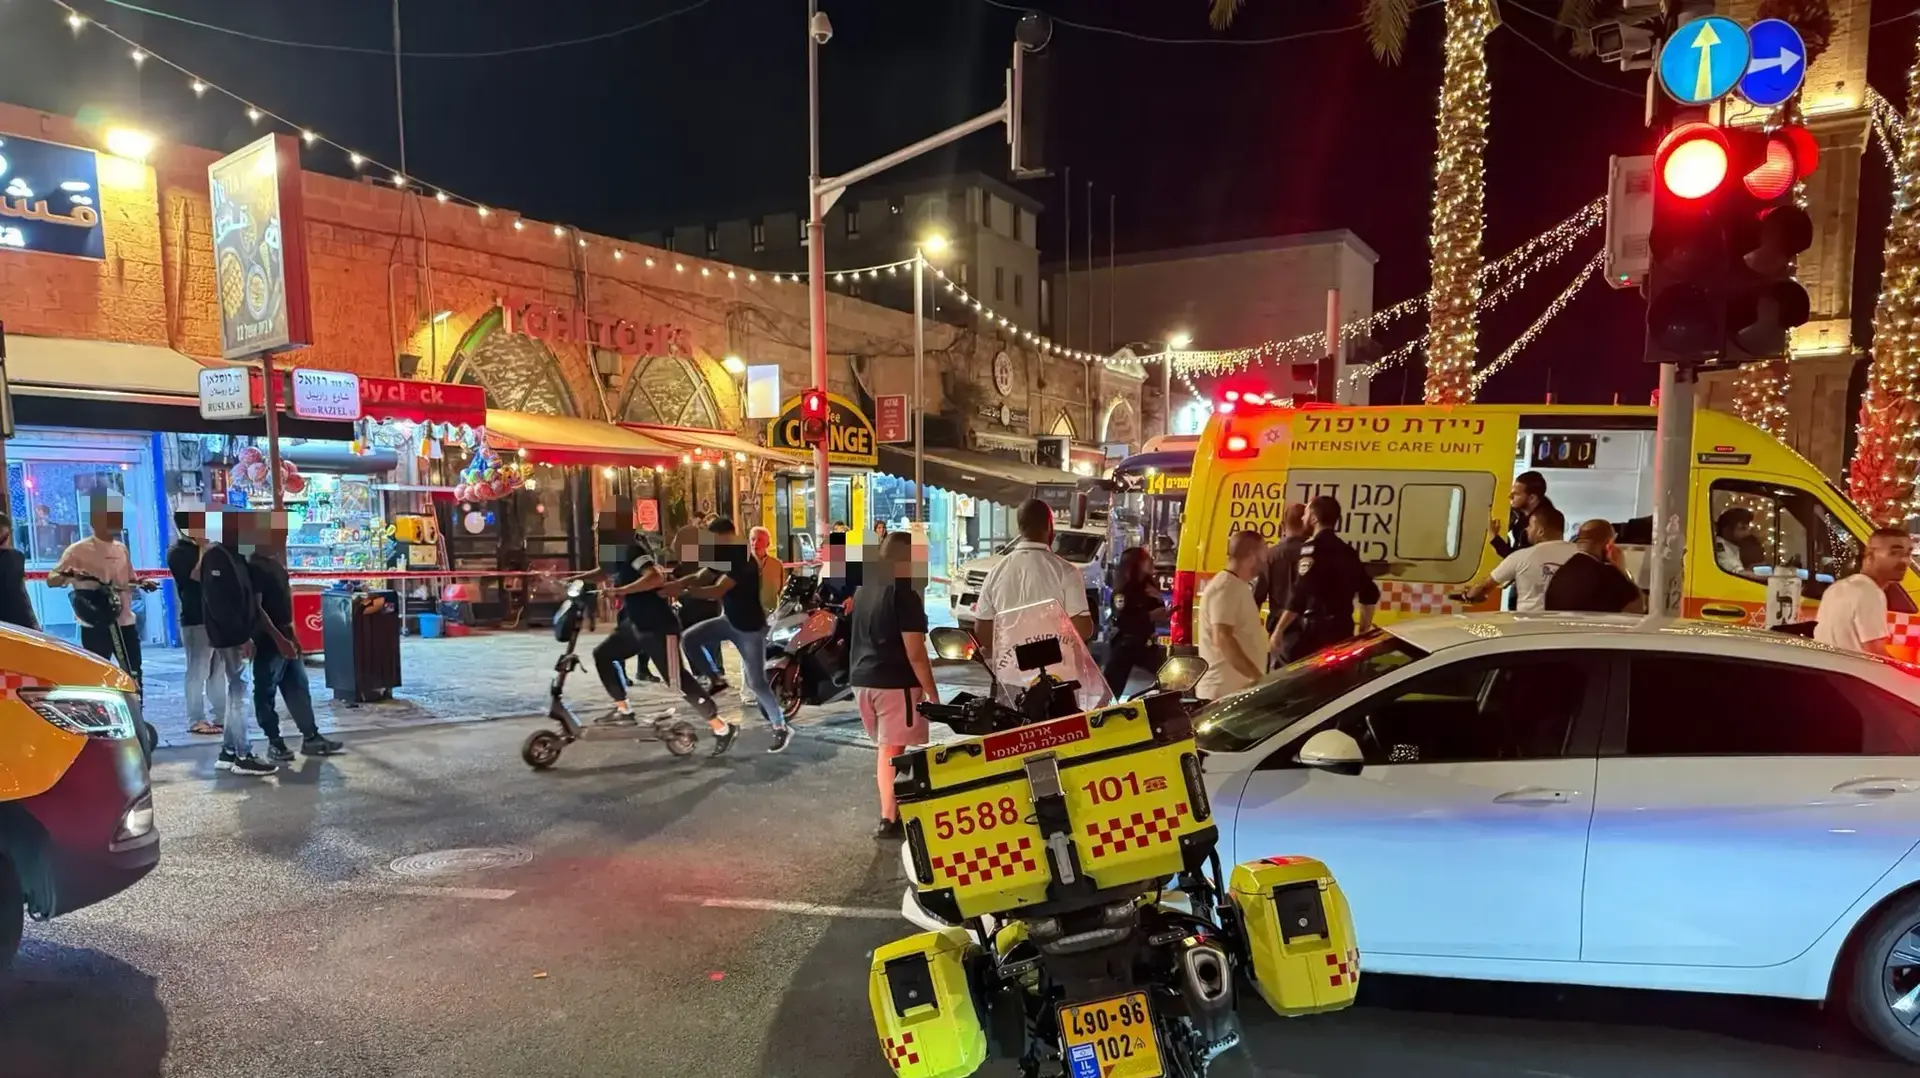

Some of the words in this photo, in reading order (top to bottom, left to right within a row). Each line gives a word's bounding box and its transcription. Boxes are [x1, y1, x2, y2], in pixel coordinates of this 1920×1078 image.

[360, 378, 383, 403] dy
[208, 401, 236, 412] RUSLAN
[883, 398, 899, 407] ATM
[1304, 413, 1392, 434] טיפול
[1401, 415, 1486, 436] ניידת
[785, 418, 869, 454] CNGE
[1290, 440, 1382, 453] INTENSIVE
[1386, 441, 1434, 453] CARE
[1439, 442, 1486, 454] UNIT
[1146, 472, 1166, 494] 14
[1231, 482, 1287, 500] MAG
[1350, 483, 1396, 510] מגן
[1229, 502, 1282, 519] DAVI
[1018, 726, 1052, 742] ארגון
[1041, 728, 1085, 750] ההצלה
[990, 736, 1037, 759] הלאומי
[1082, 770, 1141, 806] 101
[934, 796, 1019, 841] 5588
[1072, 1001, 1145, 1037] 490-96
[1097, 1033, 1134, 1062] 102
[1080, 1060, 1092, 1071] IL
